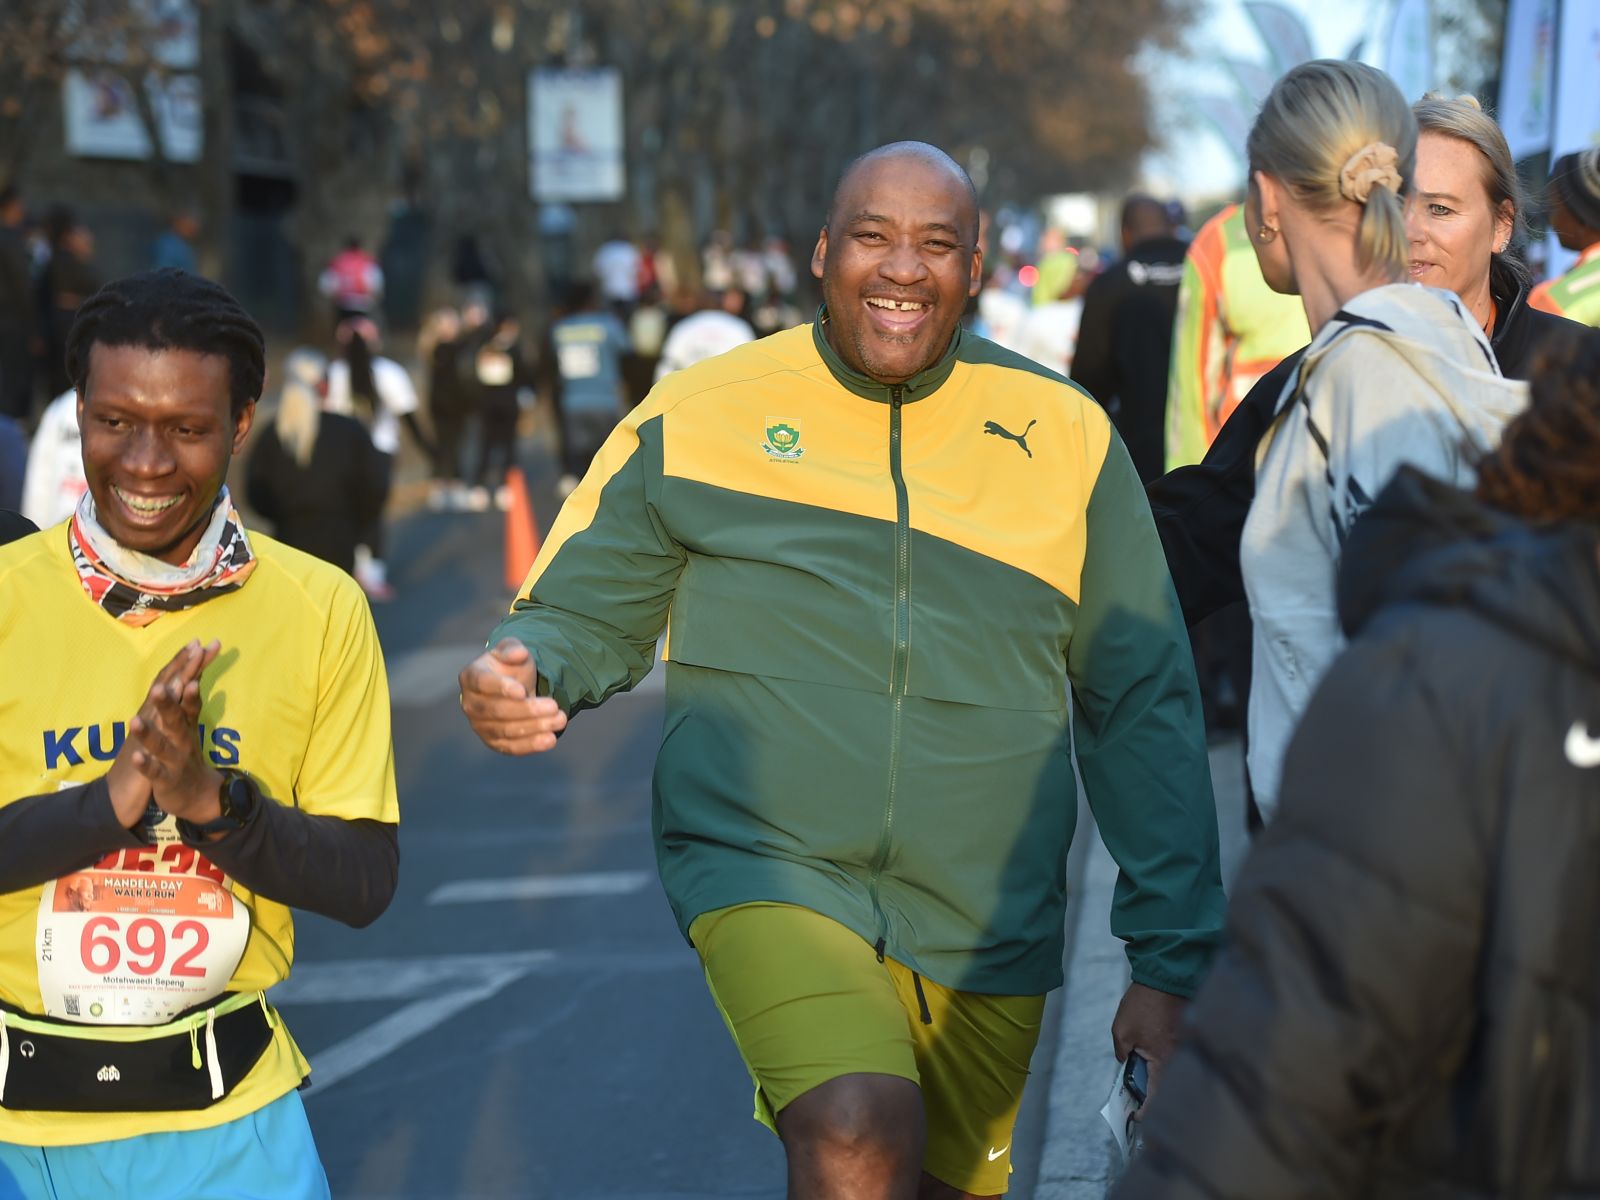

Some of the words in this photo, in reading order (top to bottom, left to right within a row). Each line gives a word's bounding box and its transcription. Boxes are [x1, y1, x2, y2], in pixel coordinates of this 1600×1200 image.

[104, 877, 158, 890] MANDELA
[160, 879, 184, 891] DAY
[114, 887, 143, 897] WALK
[154, 888, 176, 899] RUN
[42, 928, 53, 962] 21km
[80, 916, 209, 978] 692
[103, 975, 153, 985] Motshwaedi
[154, 976, 185, 988] Sepeng
